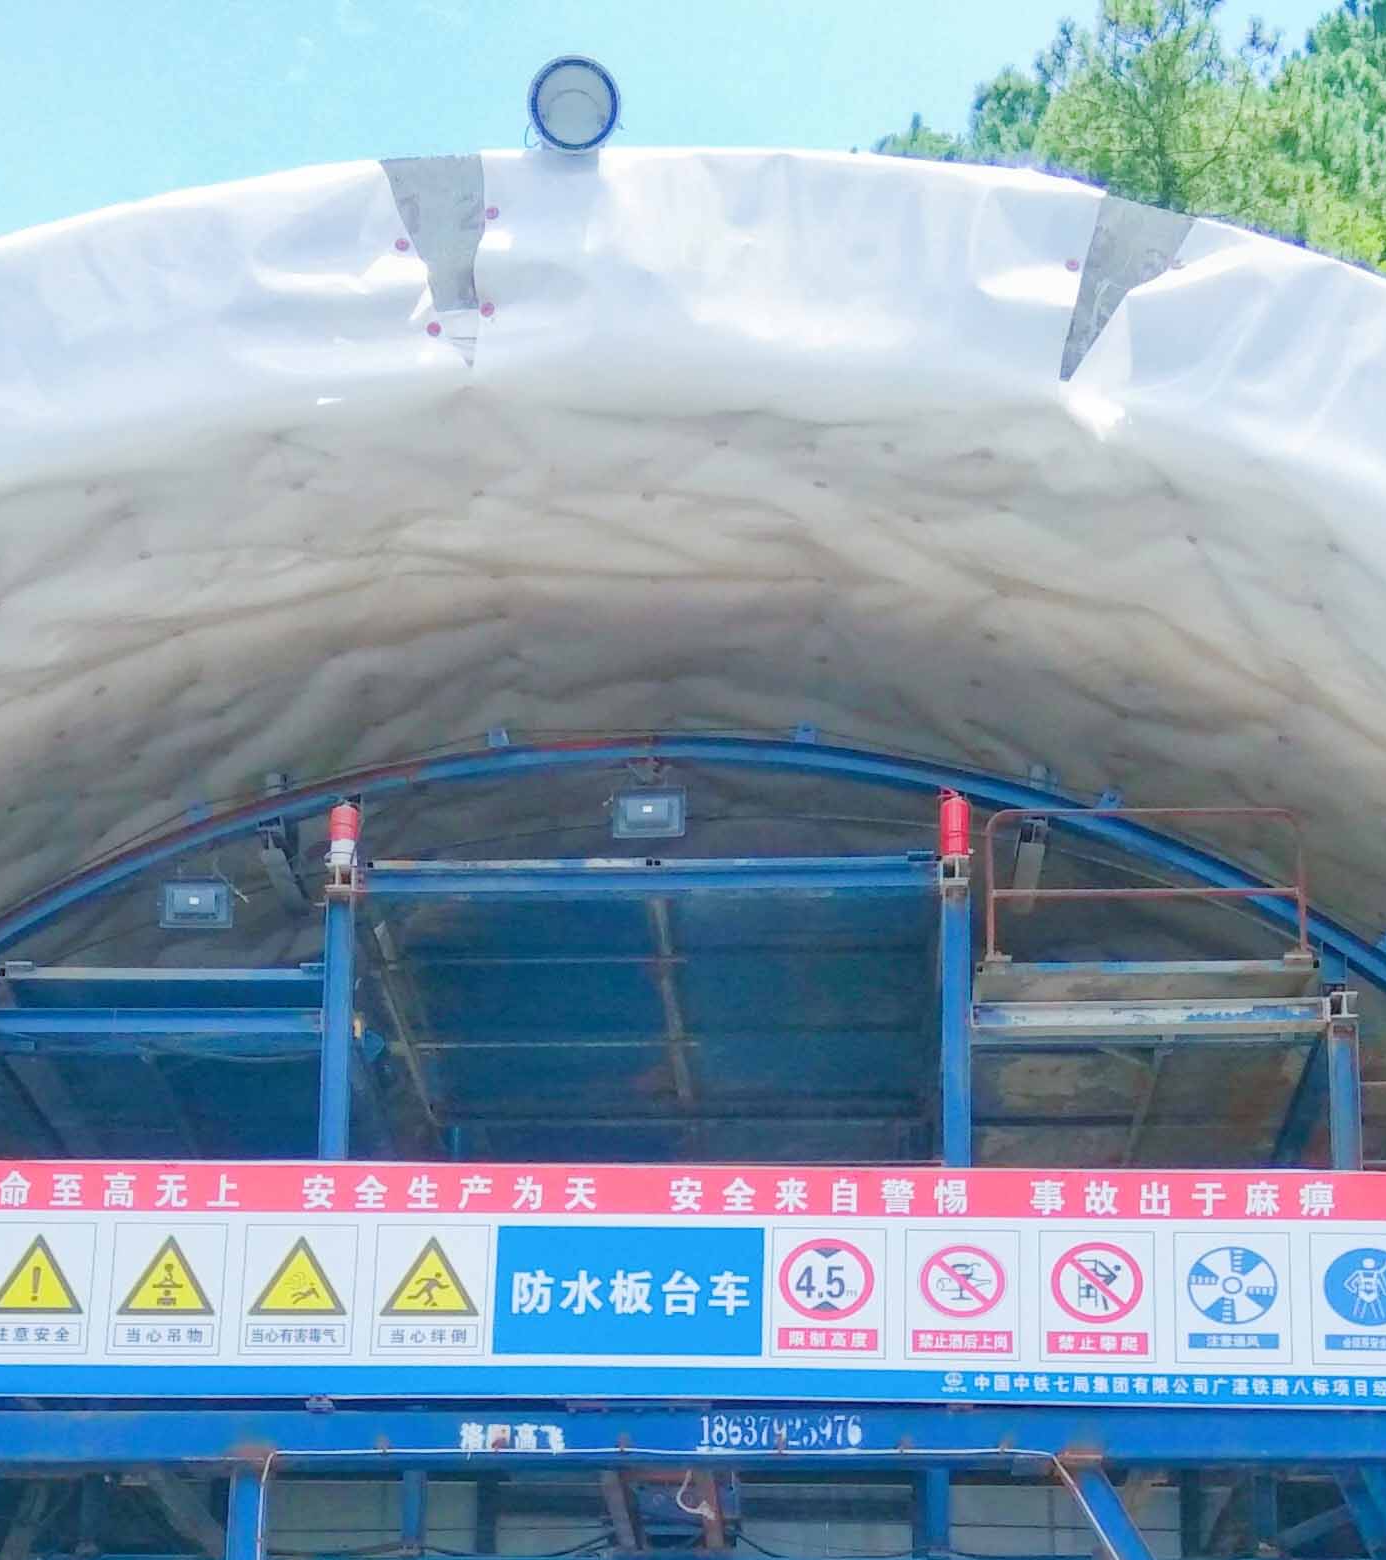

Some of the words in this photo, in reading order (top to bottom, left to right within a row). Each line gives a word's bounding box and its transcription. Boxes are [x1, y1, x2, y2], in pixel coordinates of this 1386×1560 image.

[302, 1174, 598, 1211] 安全生产为天
[669, 1177, 969, 1214] 安全来自警惕
[1029, 1179, 1337, 1217] 事故出于麻痹
[512, 1269, 751, 1316] 防水板台车
[125, 1327, 203, 1343] 当心吊物
[250, 1328, 336, 1343] 当心有害毒气
[389, 1328, 468, 1344] 当心绊倒
[788, 1331, 868, 1348] 限制高度
[917, 1332, 1008, 1351] 禁止酒后上岗
[1057, 1333, 1140, 1353] 禁止攀爬
